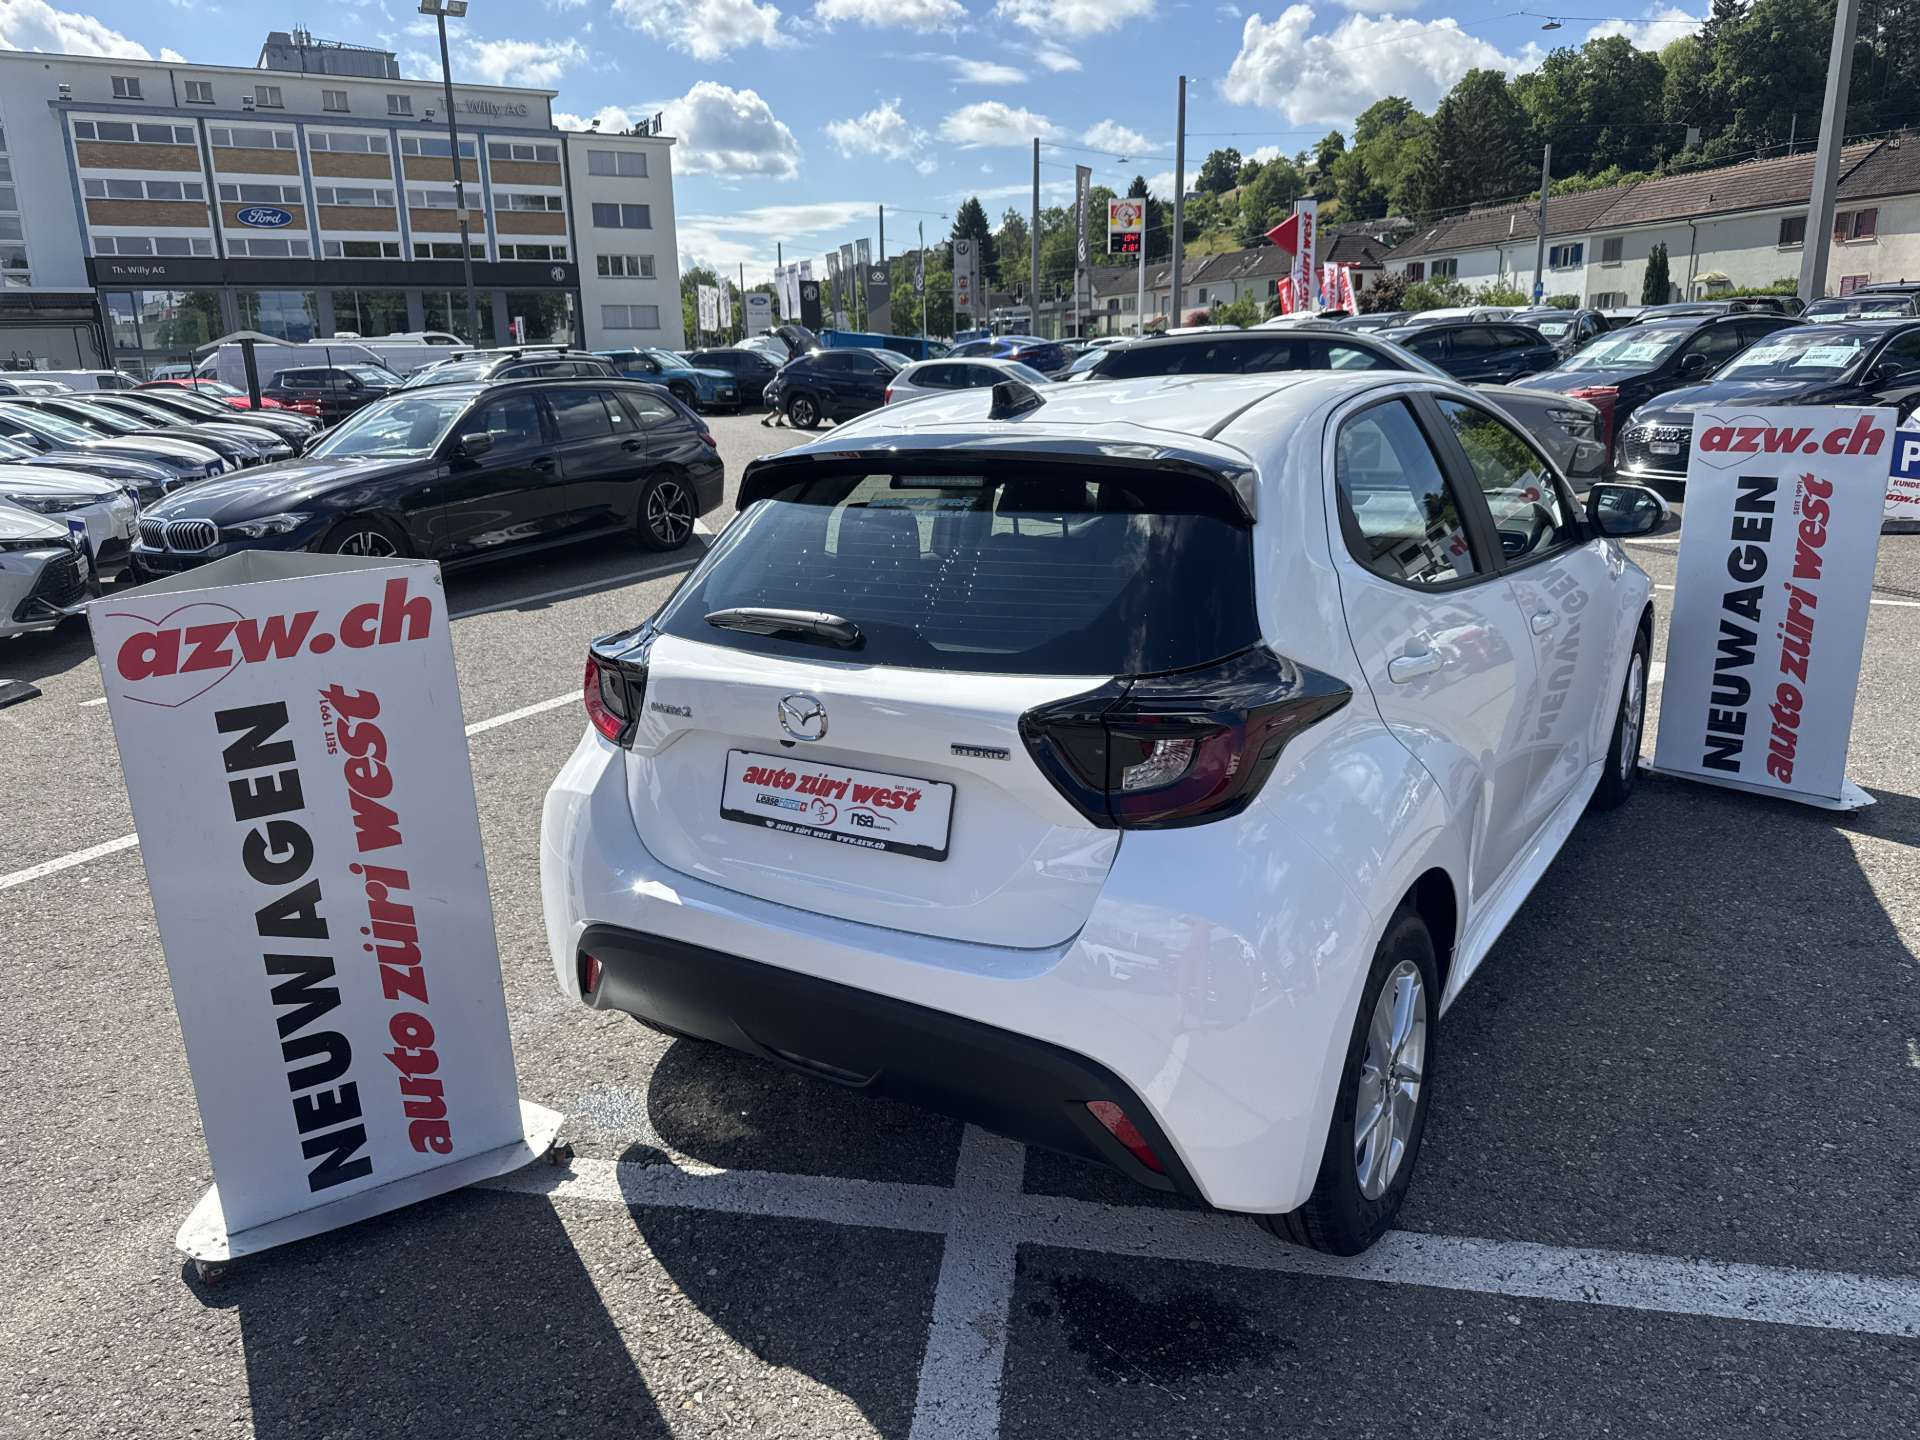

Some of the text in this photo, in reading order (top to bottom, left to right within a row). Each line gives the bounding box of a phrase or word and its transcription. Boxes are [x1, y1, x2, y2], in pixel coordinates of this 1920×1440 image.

[466, 99, 498, 117] Willy
[504, 102, 528, 115] AG
[1889, 139, 1900, 148] 48
[248, 210, 282, 224] Ford
[1303, 211, 1313, 250] west
[112, 266, 166, 275] Th. Willy AG
[1700, 415, 1885, 455] azw.ch
[1900, 440, 1920, 472] P
[1793, 500, 1801, 515] SEIT
[117, 577, 431, 681] azw.ch
[1702, 476, 1779, 773] NEUWAGEN
[1767, 472, 1833, 785] auto züri west
[319, 699, 338, 755] SEIT 1991
[954, 744, 1006, 759] HYBRID
[743, 766, 922, 811] auto züri west
[776, 823, 886, 850] auto züri west www.azw.ch
[850, 812, 875, 829] nsa
[318, 683, 453, 1156] auto züri west
[214, 701, 373, 1192] NEUWAGEN
